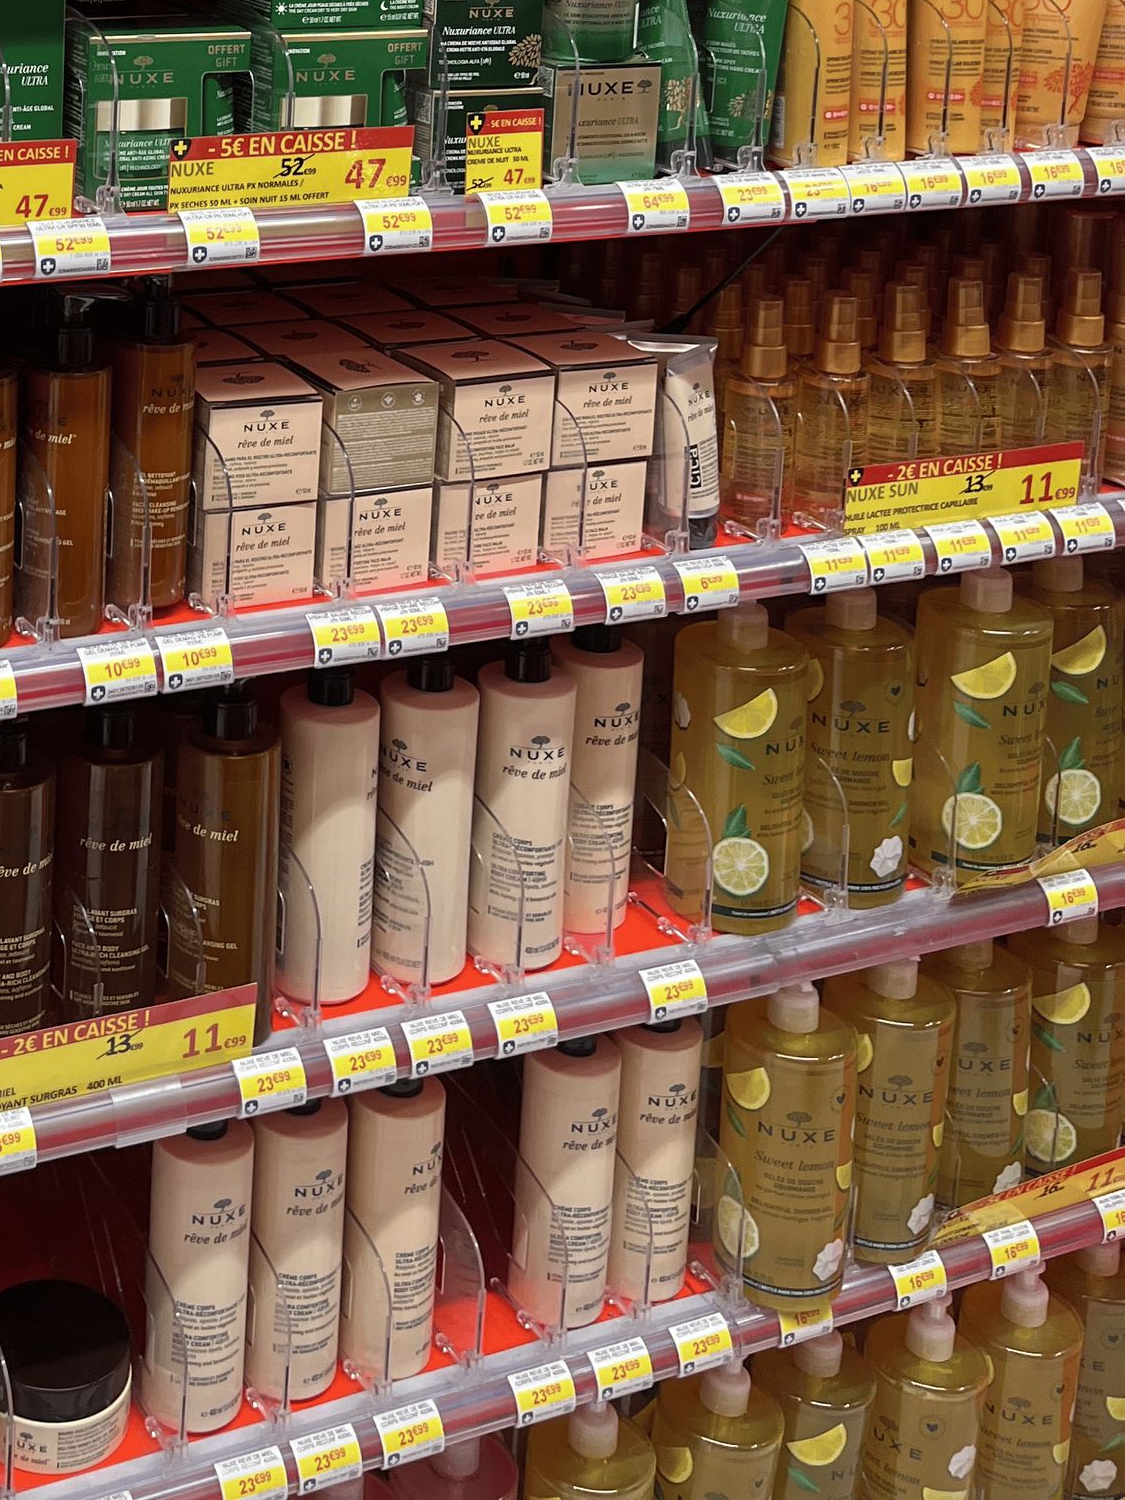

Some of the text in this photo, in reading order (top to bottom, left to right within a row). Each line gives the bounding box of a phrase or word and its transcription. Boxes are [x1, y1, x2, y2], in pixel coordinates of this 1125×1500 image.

[442, 25, 515, 36] Nuxuriance ULTRA
[221, 134, 346, 156] 5€ EN CAISSE
[170, 163, 214, 177] NUXE
[170, 180, 299, 195] NUXURIANCE ULTRA PX NORMALES
[16, 195, 67, 217] 47€99
[244, 420, 290, 432] NUXE
[237, 435, 294, 449] rêve de miel
[897, 457, 992, 481] 2€ EN CAISSE
[847, 482, 918, 503] NUXE SUN
[1020, 473, 1075, 505] 11€99
[401, 616, 434, 634] 23€99
[812, 713, 890, 733] NUXE
[510, 746, 565, 760] NUXE
[757, 1121, 836, 1143] NUXE
[754, 1150, 835, 1172] Sweet lemon
[1004, 1242, 1028, 1259] 16€99
[398, 1423, 429, 1446] 23€99
